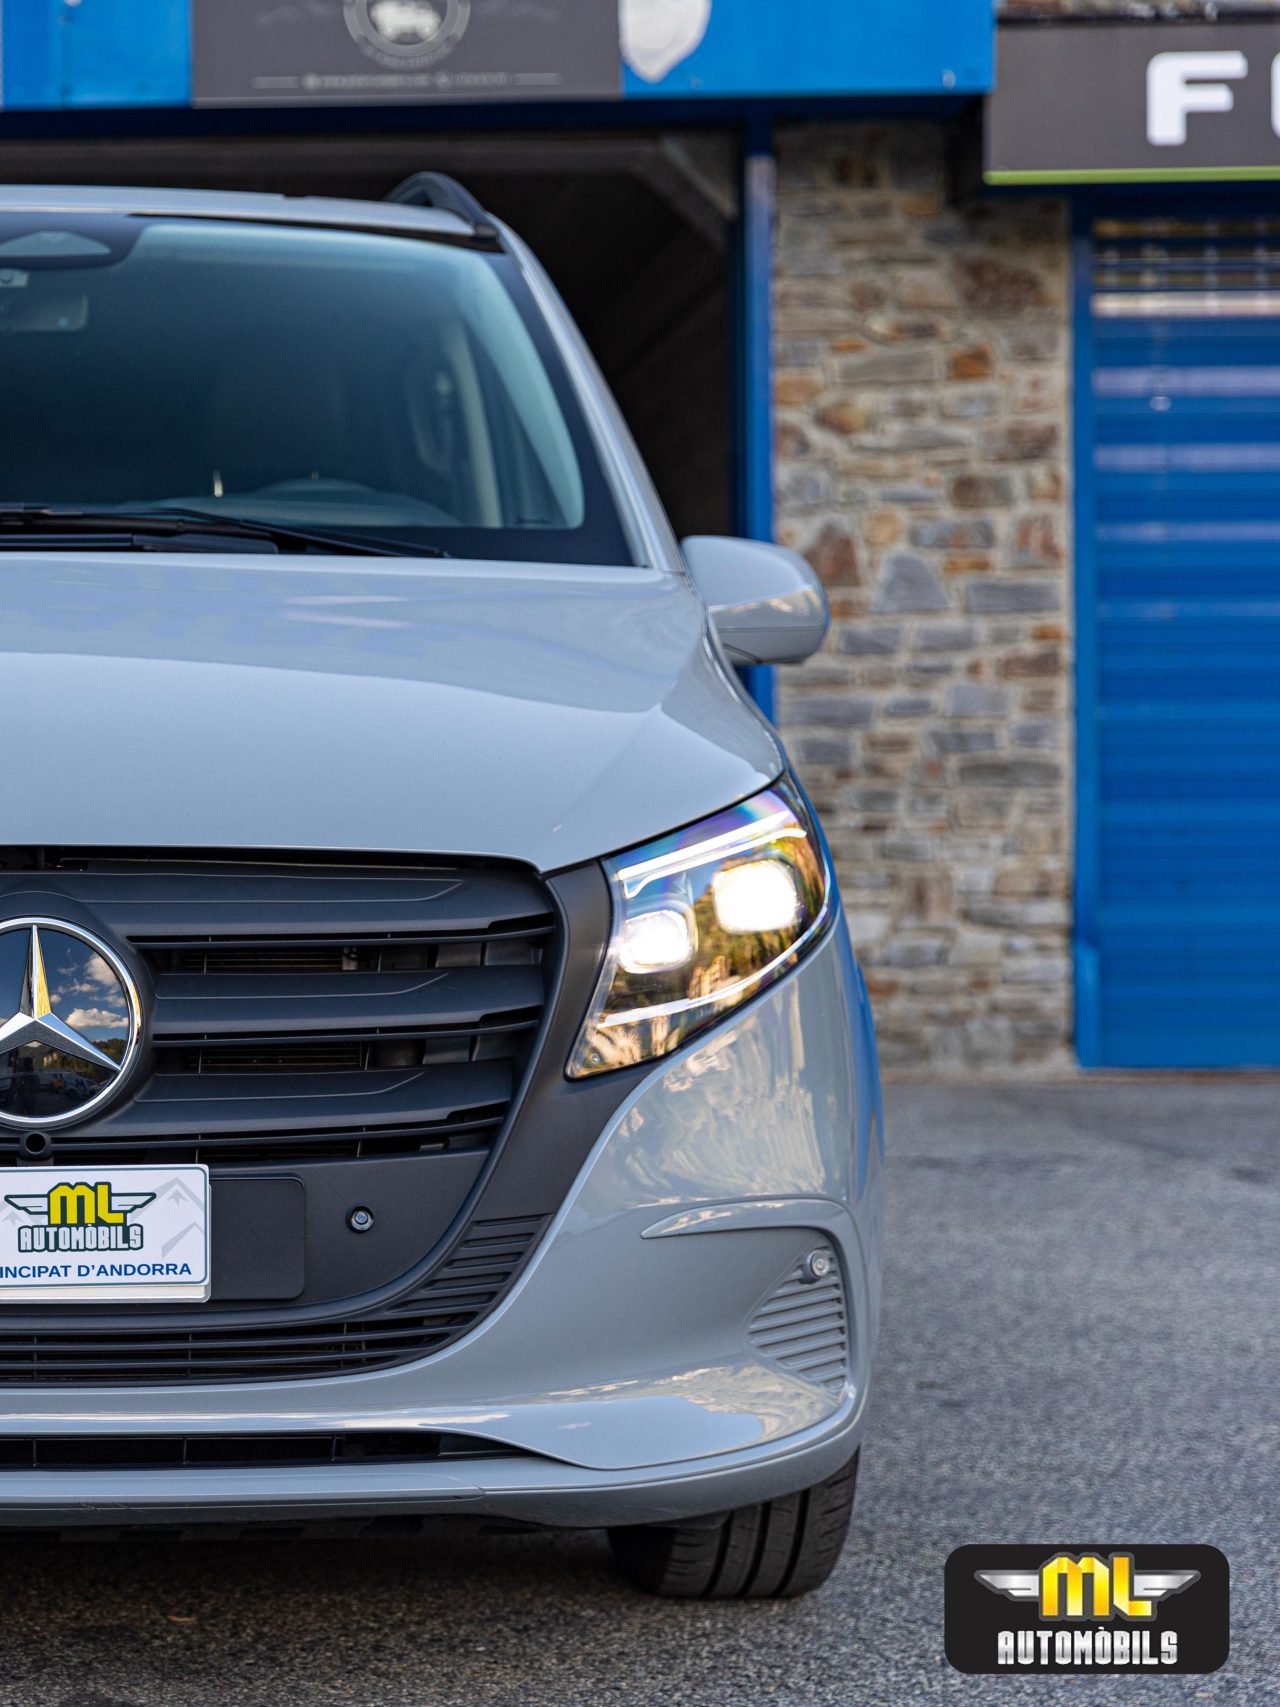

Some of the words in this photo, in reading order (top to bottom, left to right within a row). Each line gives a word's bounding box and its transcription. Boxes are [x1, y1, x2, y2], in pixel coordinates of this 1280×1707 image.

[1146, 50, 1280, 146] F
[48, 1182, 125, 1225] ML
[77, 1262, 193, 1277] D’ANDORRA
